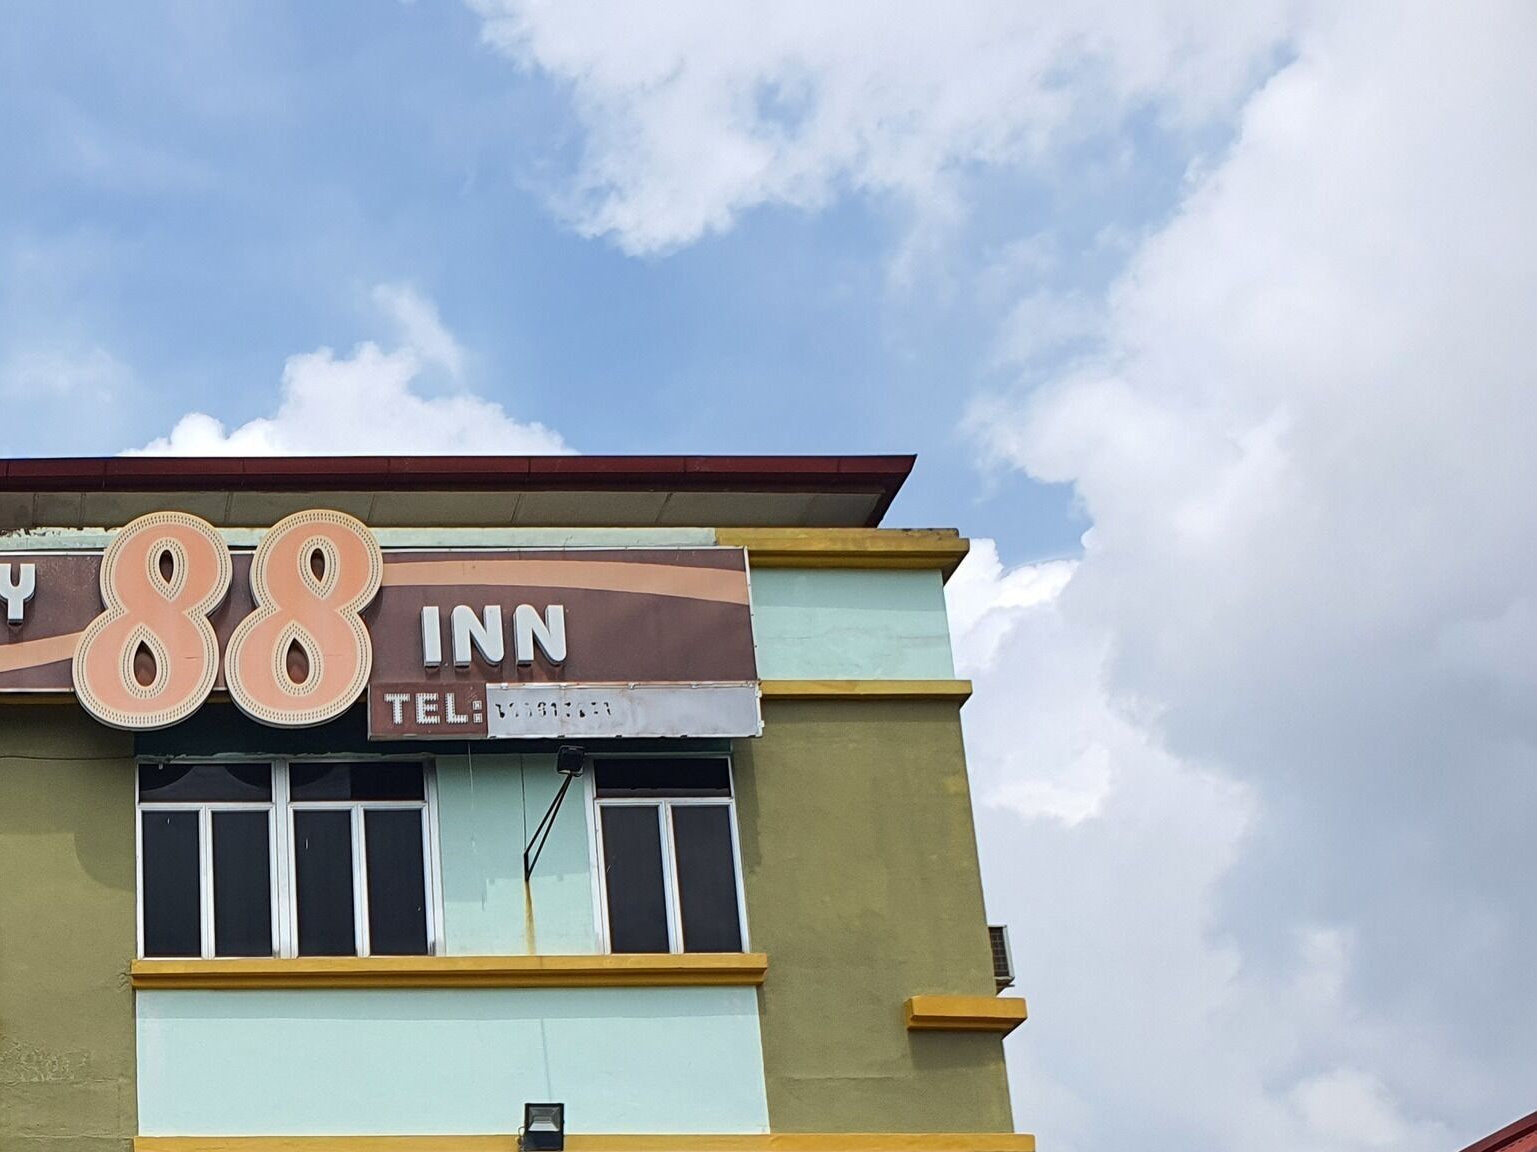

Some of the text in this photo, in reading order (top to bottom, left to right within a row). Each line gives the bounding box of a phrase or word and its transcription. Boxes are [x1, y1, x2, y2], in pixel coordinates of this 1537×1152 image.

[72, 509, 382, 730] 88
[420, 603, 568, 669] INN
[383, 692, 484, 726] TEL:
